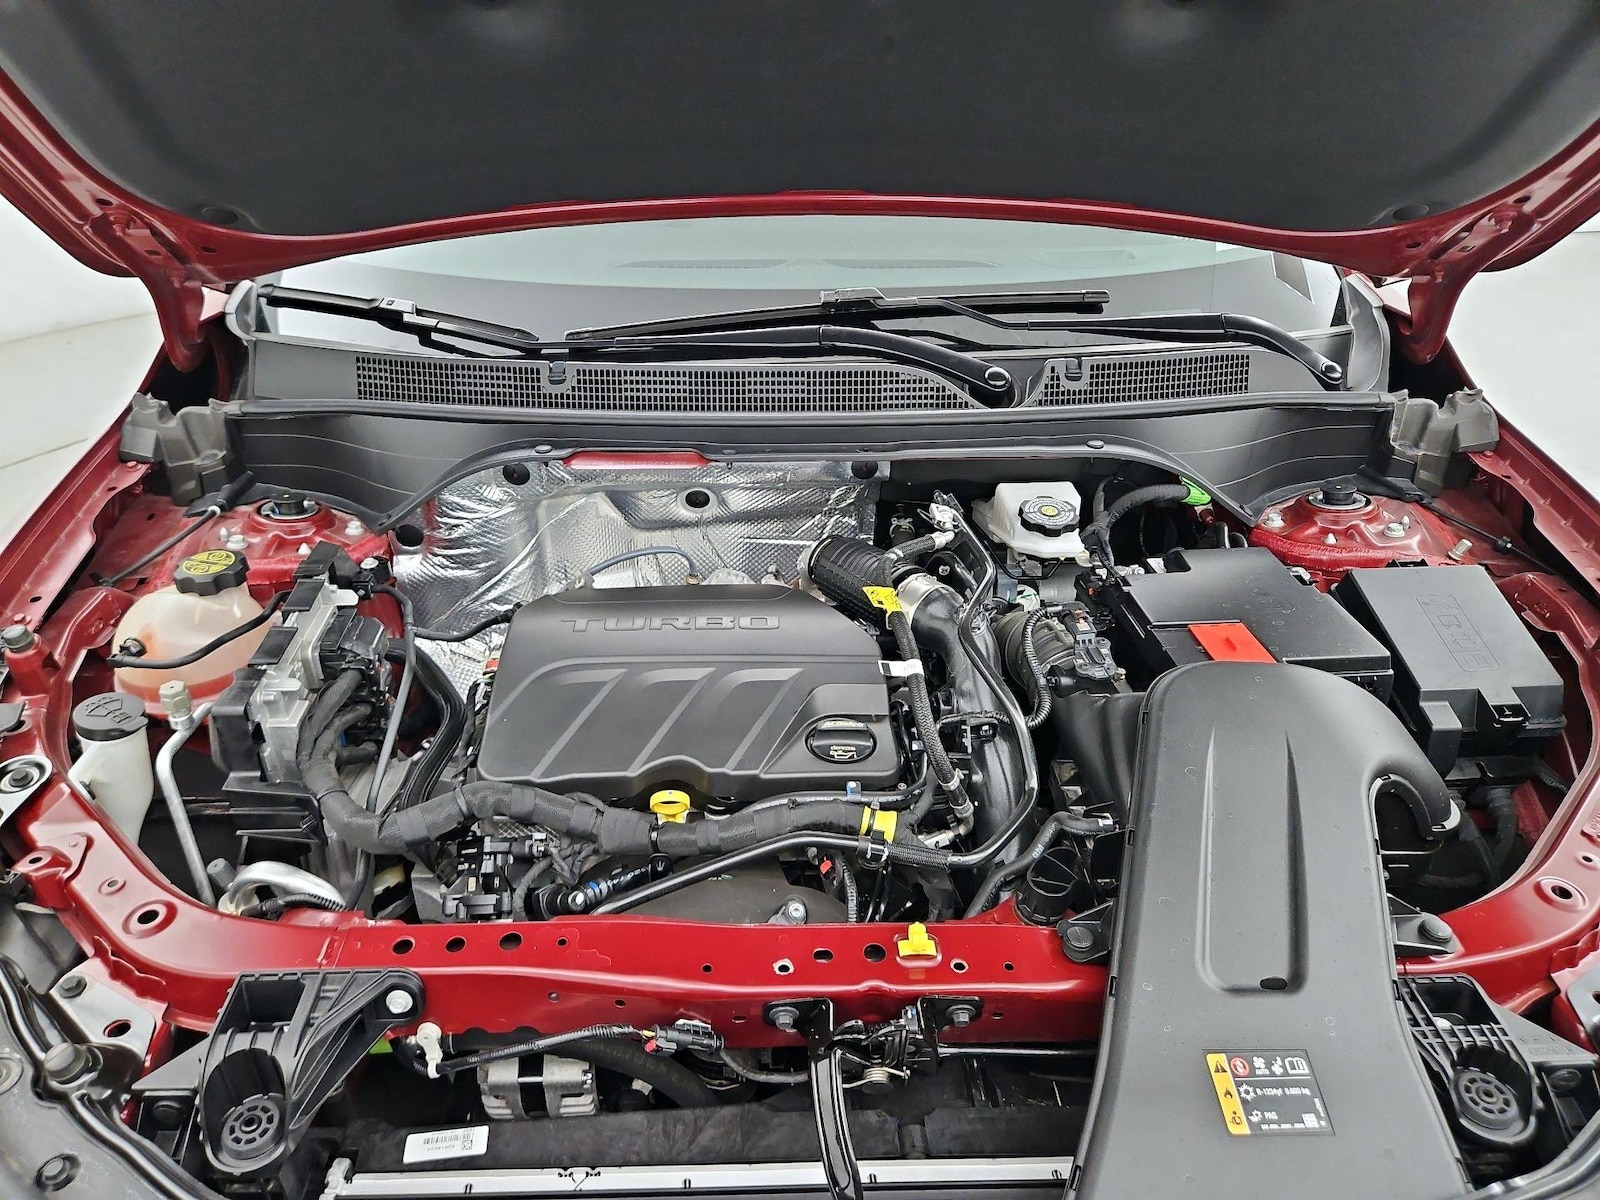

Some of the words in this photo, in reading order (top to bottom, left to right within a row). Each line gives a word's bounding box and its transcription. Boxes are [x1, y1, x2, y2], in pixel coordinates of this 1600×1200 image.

[561, 616, 780, 632] TURBO
[1256, 1087, 1283, 1096] R-1234yf
[1264, 1111, 1279, 1120] PAG
